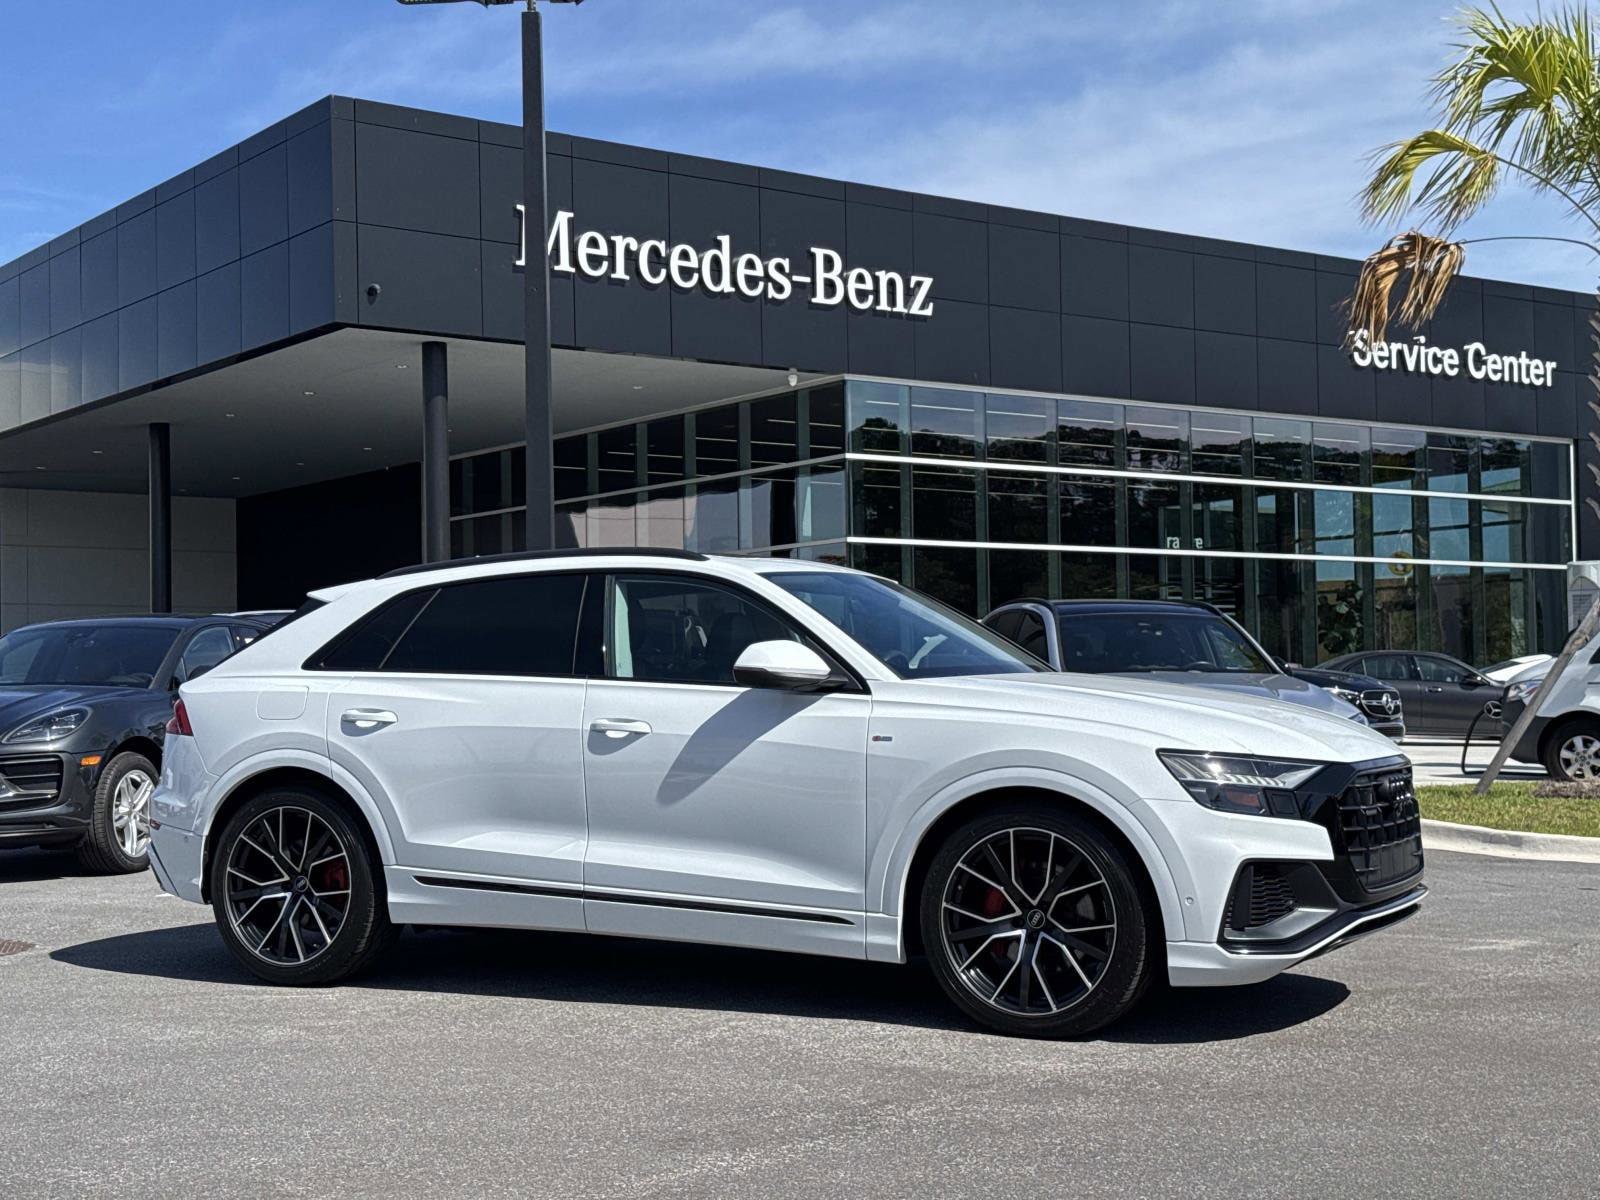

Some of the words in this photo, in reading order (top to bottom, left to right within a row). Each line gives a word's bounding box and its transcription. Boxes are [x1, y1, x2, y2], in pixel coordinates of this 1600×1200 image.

[515, 204, 934, 316] Mercedes-Benz
[1351, 328, 1459, 376] Service
[1465, 342, 1557, 387] Center
